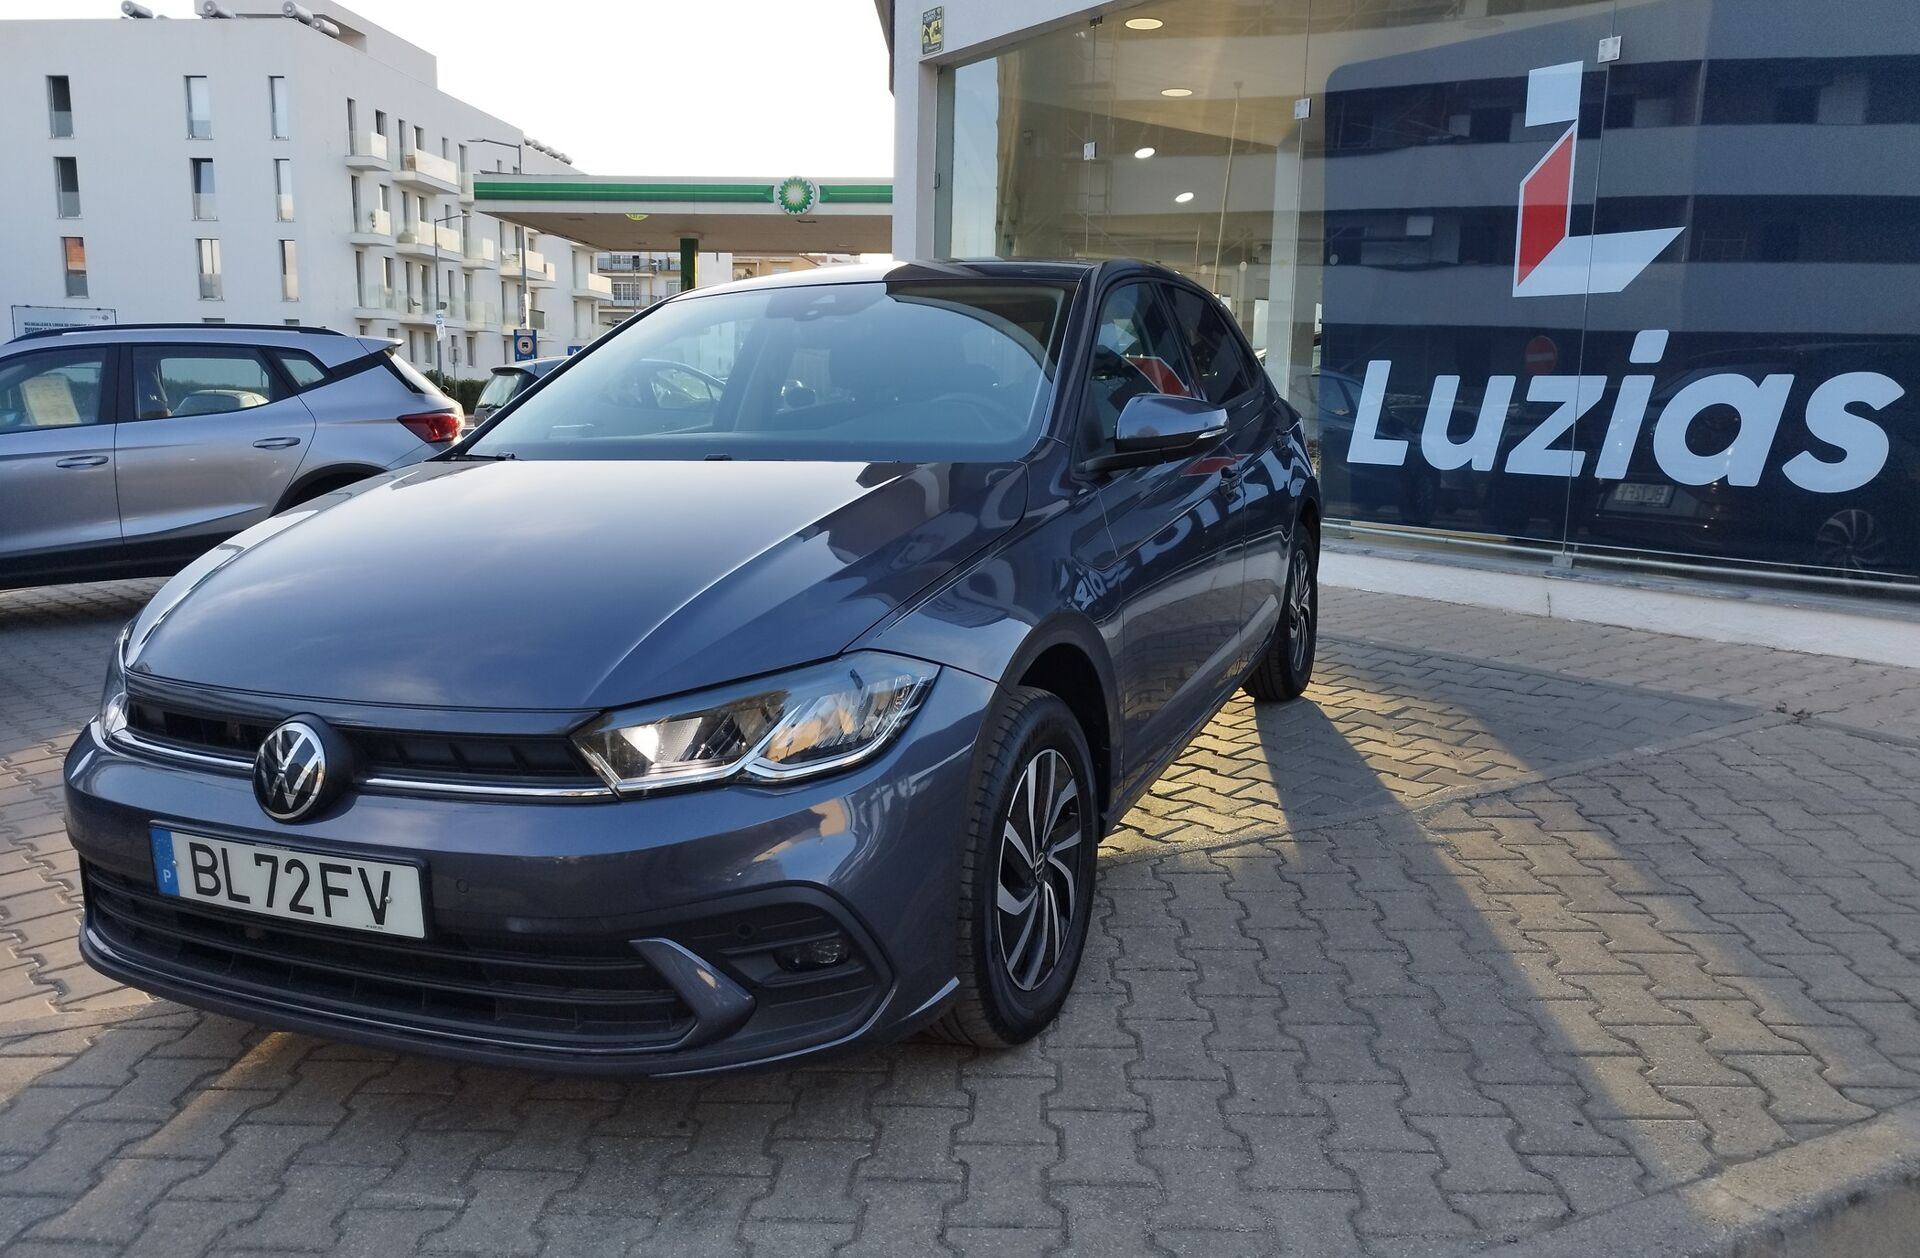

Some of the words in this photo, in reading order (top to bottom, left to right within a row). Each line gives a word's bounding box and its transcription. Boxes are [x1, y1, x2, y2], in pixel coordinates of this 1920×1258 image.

[1347, 330, 1905, 493] Luzias
[163, 869, 171, 883] P
[189, 842, 391, 925] BL72FV
